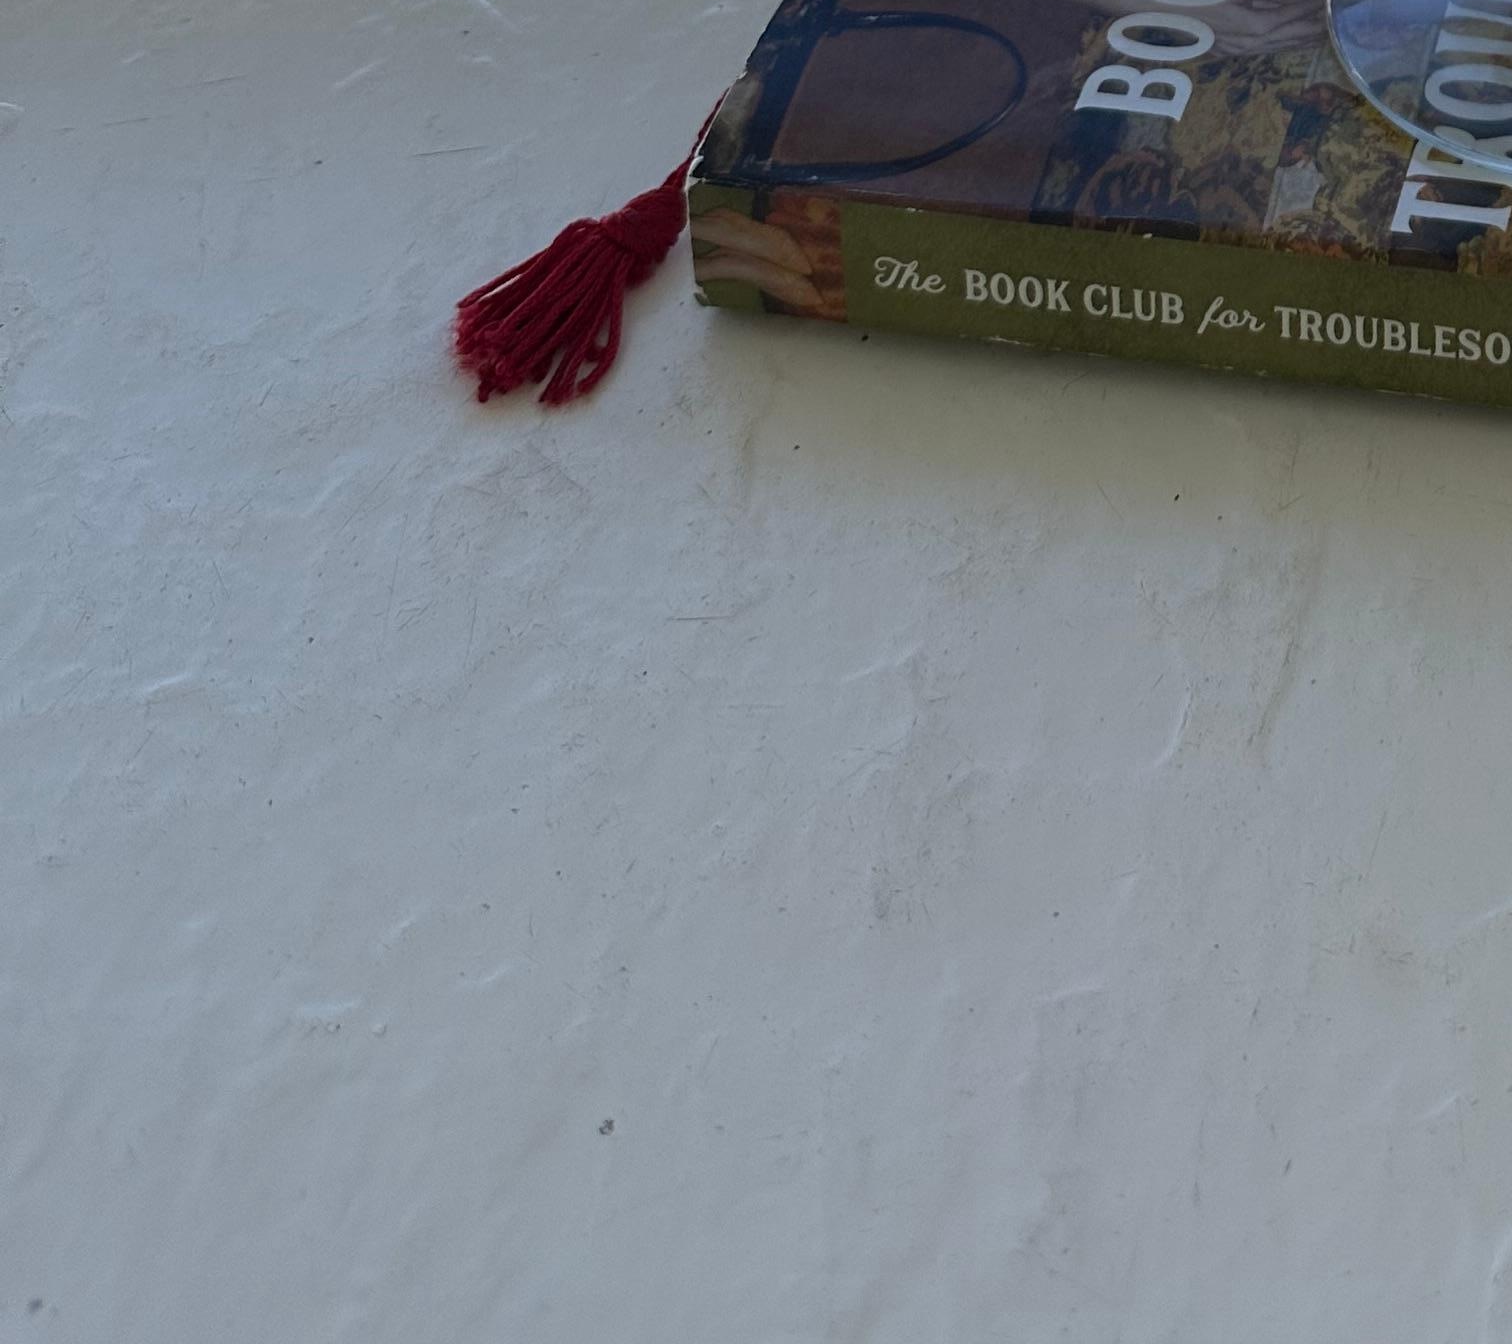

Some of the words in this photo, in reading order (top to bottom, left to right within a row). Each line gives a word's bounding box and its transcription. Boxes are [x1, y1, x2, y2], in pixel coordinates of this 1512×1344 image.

[873, 255, 947, 295] The
[963, 268, 1073, 313] BOOK
[1082, 283, 1185, 325] CLUB
[1197, 295, 1267, 335] for
